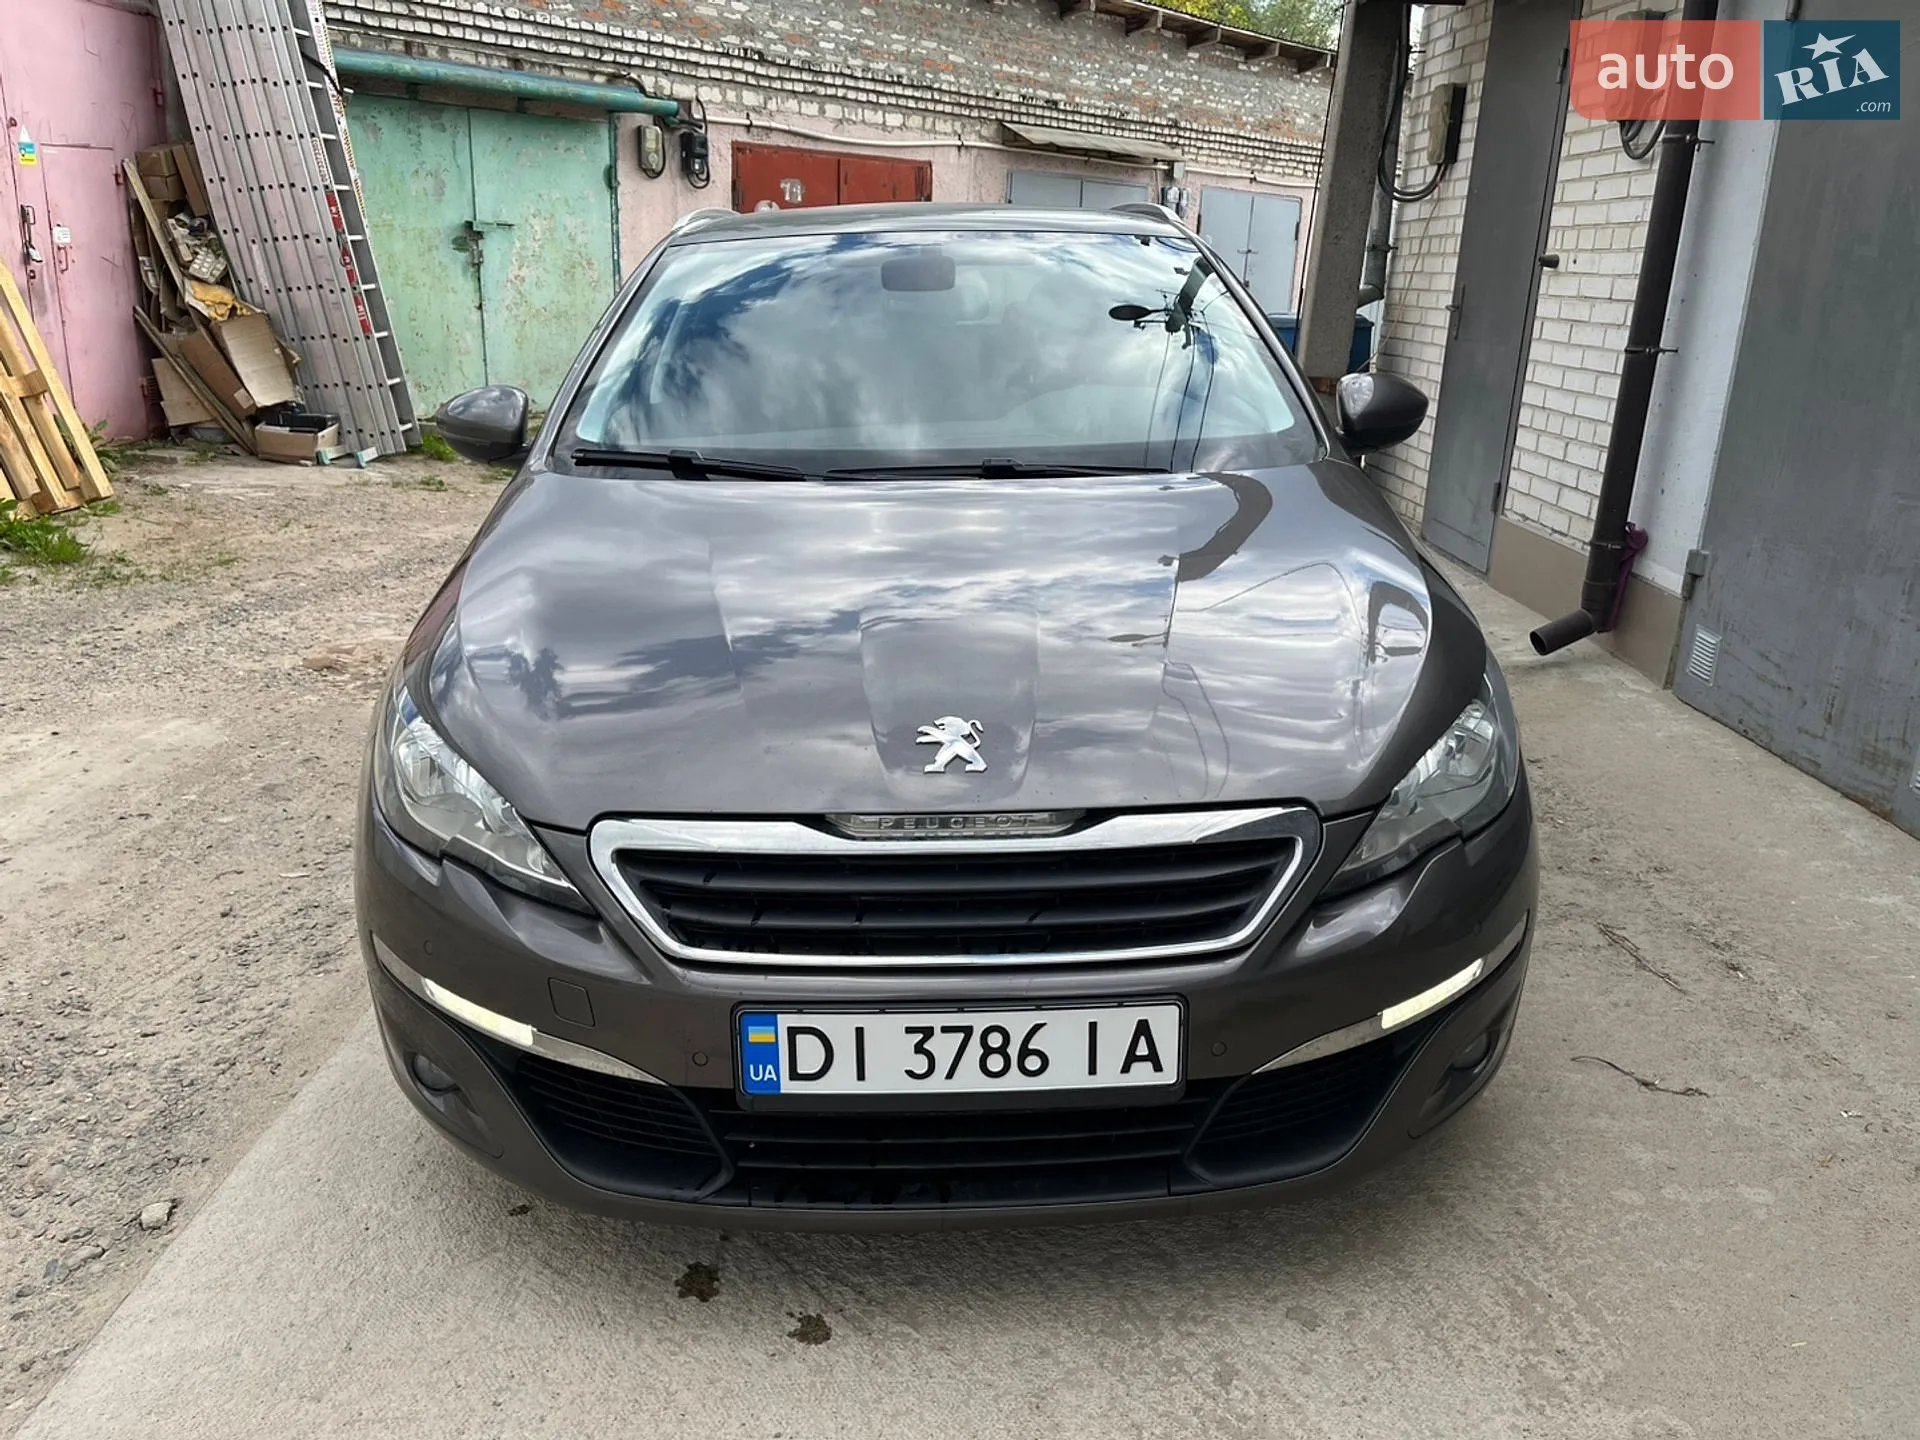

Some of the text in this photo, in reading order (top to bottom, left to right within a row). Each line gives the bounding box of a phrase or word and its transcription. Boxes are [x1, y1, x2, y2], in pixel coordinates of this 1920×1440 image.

[878, 815, 1036, 830] PEUGEOT
[787, 1018, 1164, 1082] DI 3786 IA
[749, 1064, 778, 1083] UA
